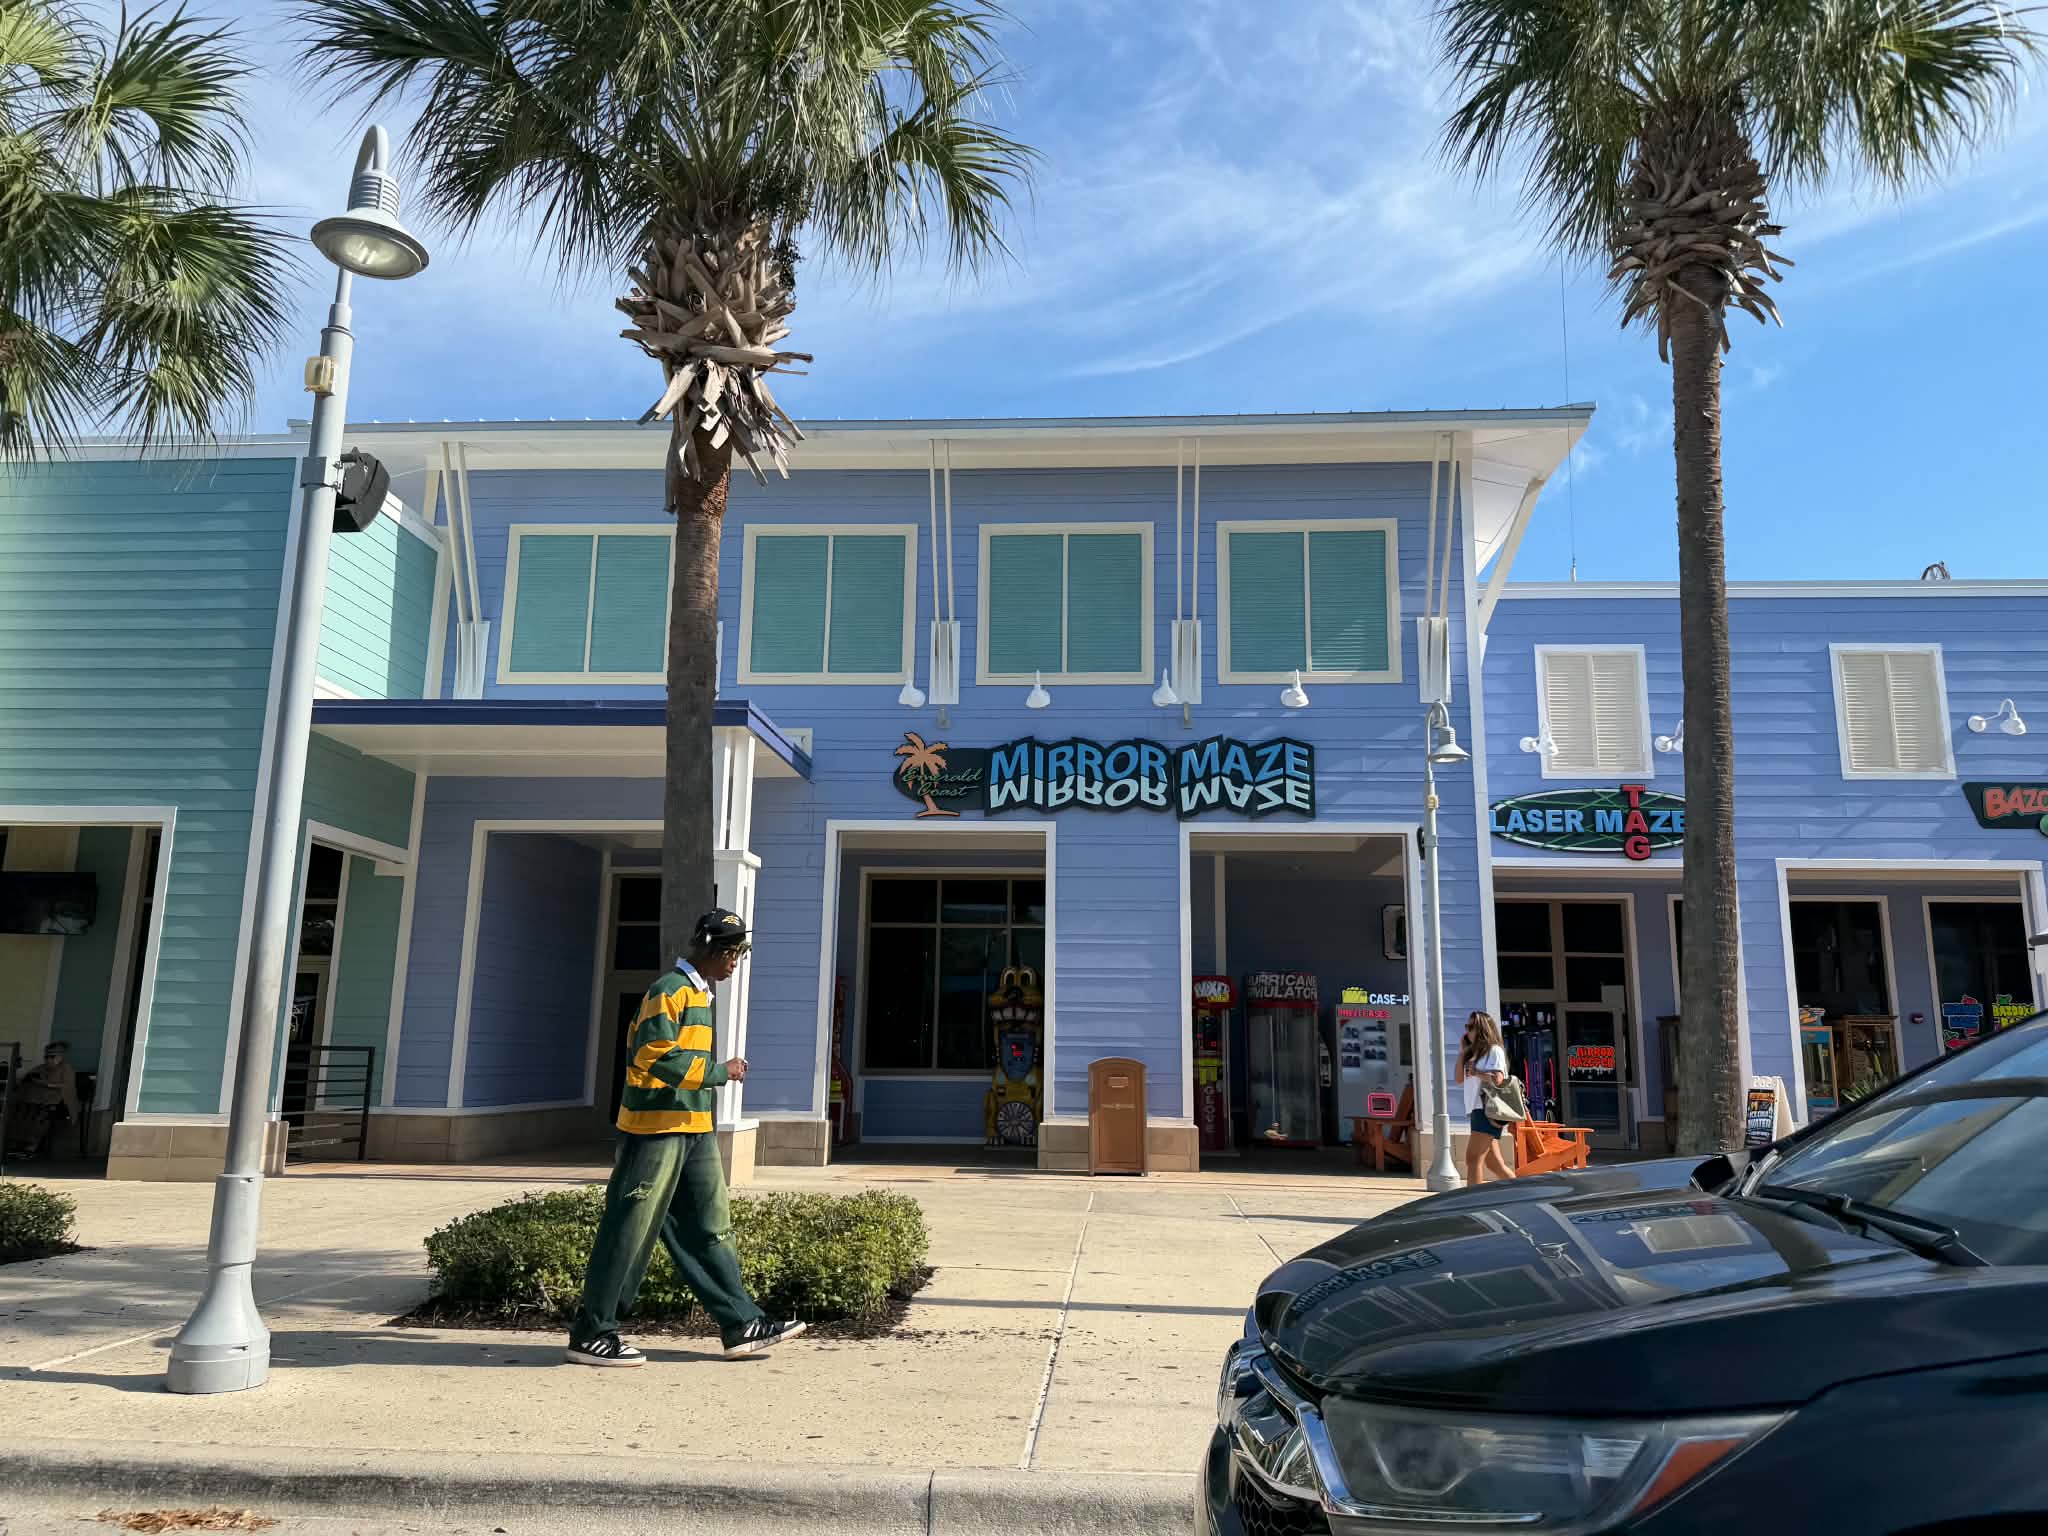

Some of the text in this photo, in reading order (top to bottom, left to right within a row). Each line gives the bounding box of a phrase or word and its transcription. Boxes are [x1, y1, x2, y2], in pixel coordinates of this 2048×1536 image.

[902, 767, 984, 782] Emerald
[990, 741, 1310, 785] MIRROR MAZE
[917, 782, 980, 797] Coast
[1489, 809, 1585, 833] LASER
[1622, 784, 1651, 860] TAG
